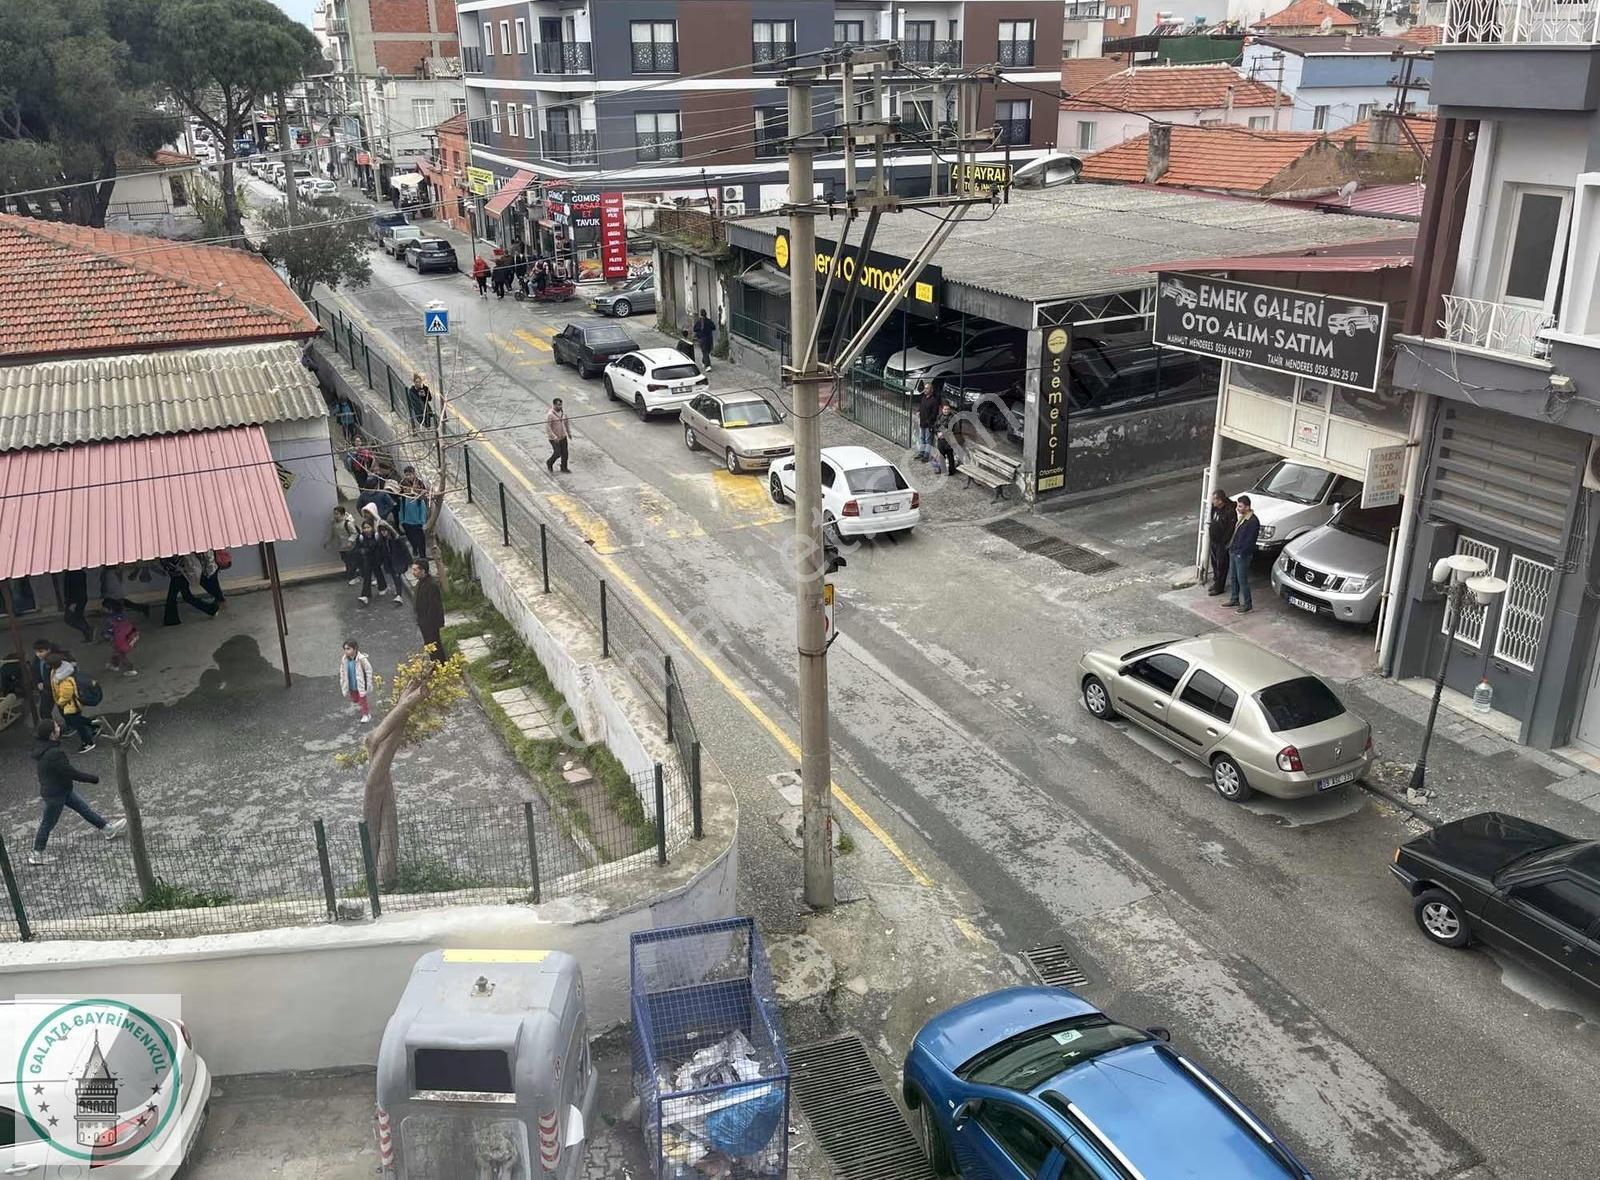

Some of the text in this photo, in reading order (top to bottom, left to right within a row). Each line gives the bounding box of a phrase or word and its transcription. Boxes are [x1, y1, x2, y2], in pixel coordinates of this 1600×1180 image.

[571, 194, 600, 203] GÜMÜŞ
[576, 218, 601, 226] TAVUK
[1199, 284, 1325, 328] EMEK GALERİ
[1182, 312, 1220, 334] OTO
[1167, 333, 1188, 346] MAHMUT
[1189, 338, 1214, 352] MENDERES
[1215, 342, 1227, 354] 0536
[1284, 358, 1313, 373] MENDERES
[1314, 362, 1329, 376] 0536
[1329, 367, 1341, 379] 305
[1341, 369, 1349, 380] 25
[1349, 371, 1359, 382] 07
[1048, 358, 1062, 465] semerci
